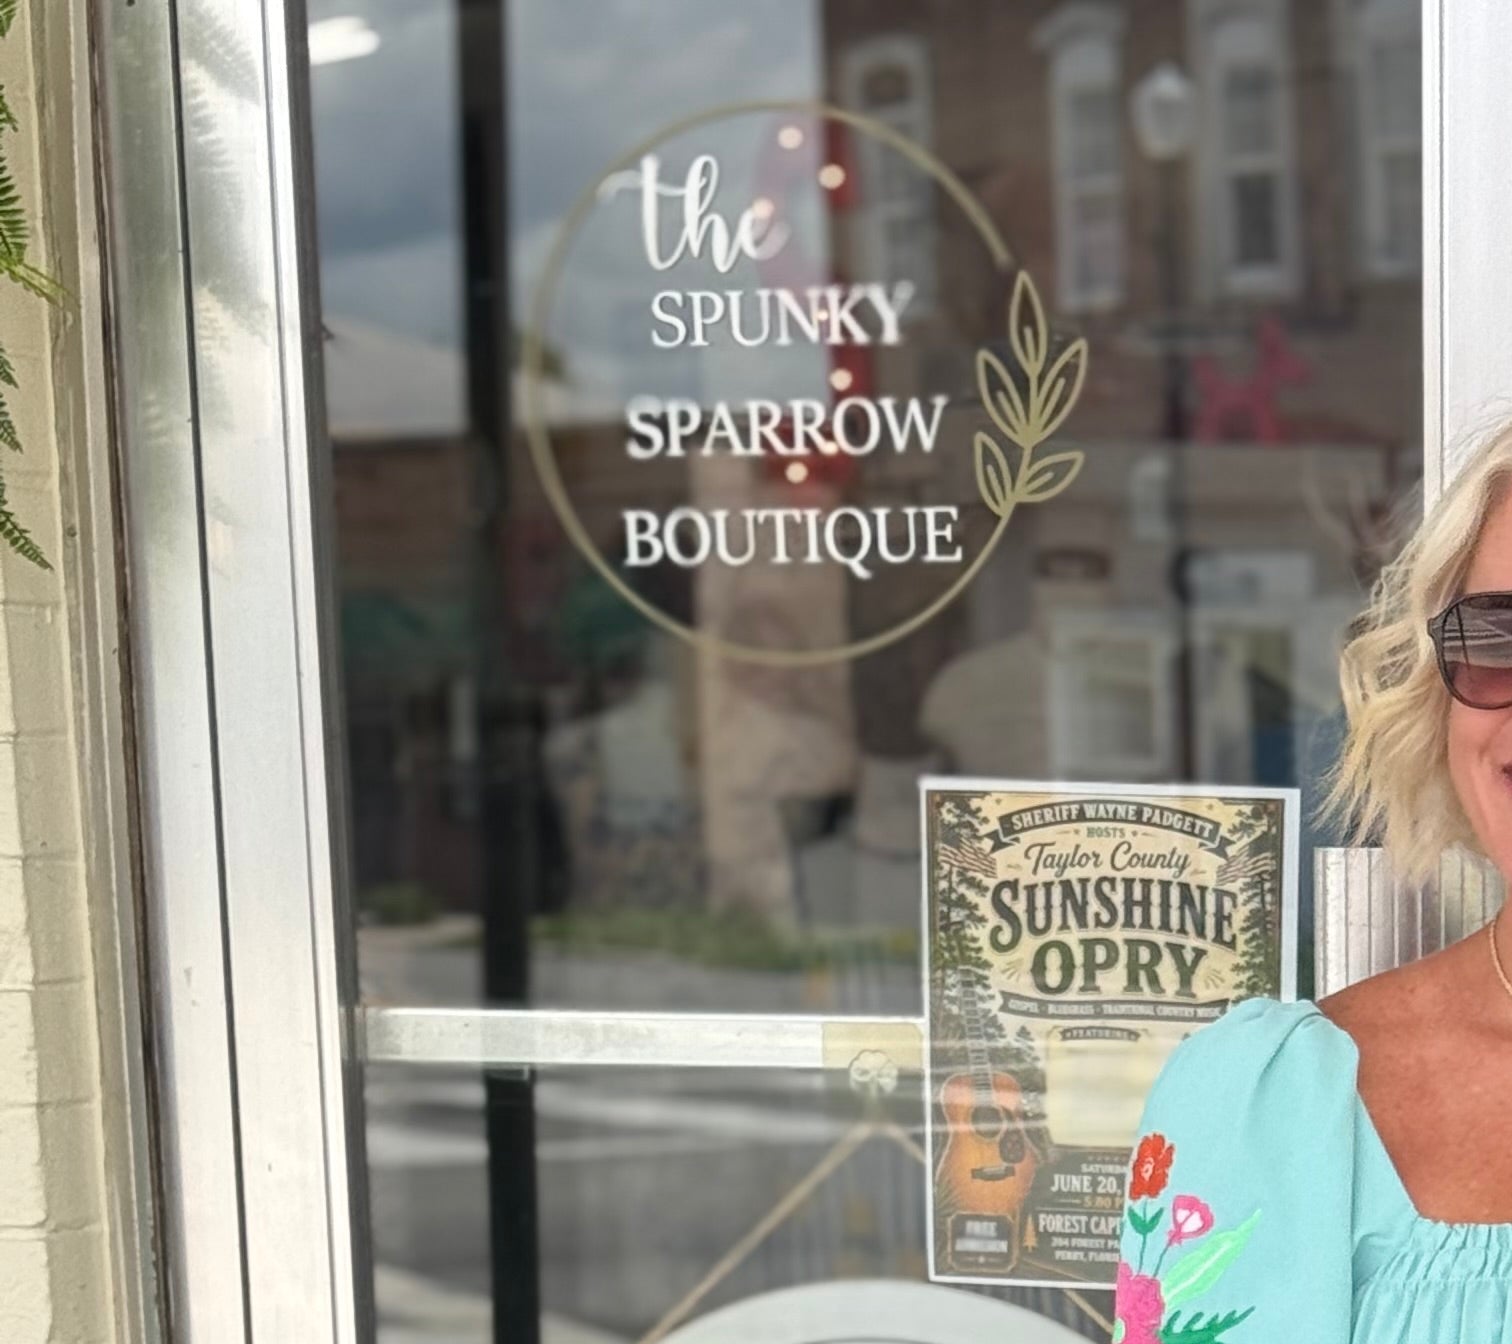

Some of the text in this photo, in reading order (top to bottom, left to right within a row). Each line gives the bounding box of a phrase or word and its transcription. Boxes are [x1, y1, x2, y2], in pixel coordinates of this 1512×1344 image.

[598, 153, 792, 273] the
[650, 280, 916, 349] SPUNKY
[625, 394, 948, 460] SPARROW
[621, 506, 964, 580] BOUTIQUE
[1011, 803, 1214, 838] SHERIFF WAYNE PADGETT
[1086, 826, 1126, 839] HOSTS
[1023, 840, 1192, 879] Taylor County
[989, 876, 1239, 954] SUNSHINE
[1030, 937, 1209, 999] OPRY
[1050, 1173, 1122, 1196] JUNE 20,
[1038, 1213, 1088, 1234] FOREST
